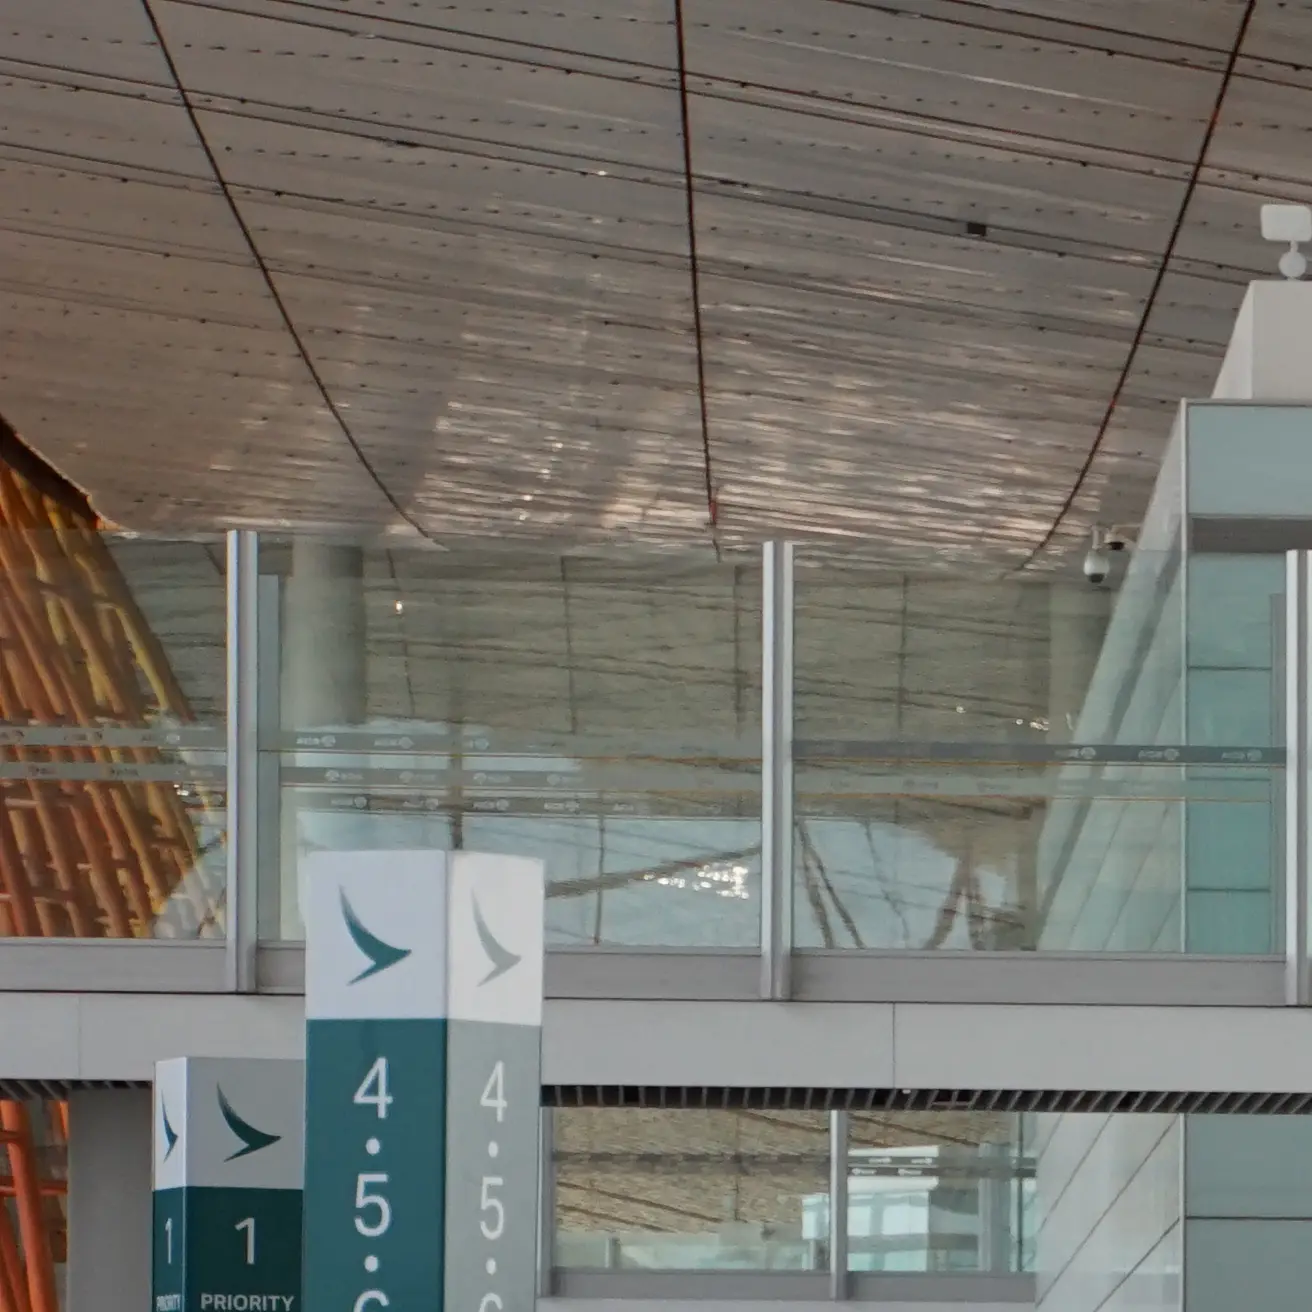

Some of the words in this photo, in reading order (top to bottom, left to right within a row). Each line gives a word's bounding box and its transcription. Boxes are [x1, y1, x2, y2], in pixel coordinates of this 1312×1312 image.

[353, 1057, 393, 1118] 4
[480, 1061, 508, 1122] 4
[353, 1172, 390, 1237] 5
[479, 1177, 505, 1240] 5
[234, 1217, 255, 1265] 1
[200, 1293, 294, 1312] PRIORITY
